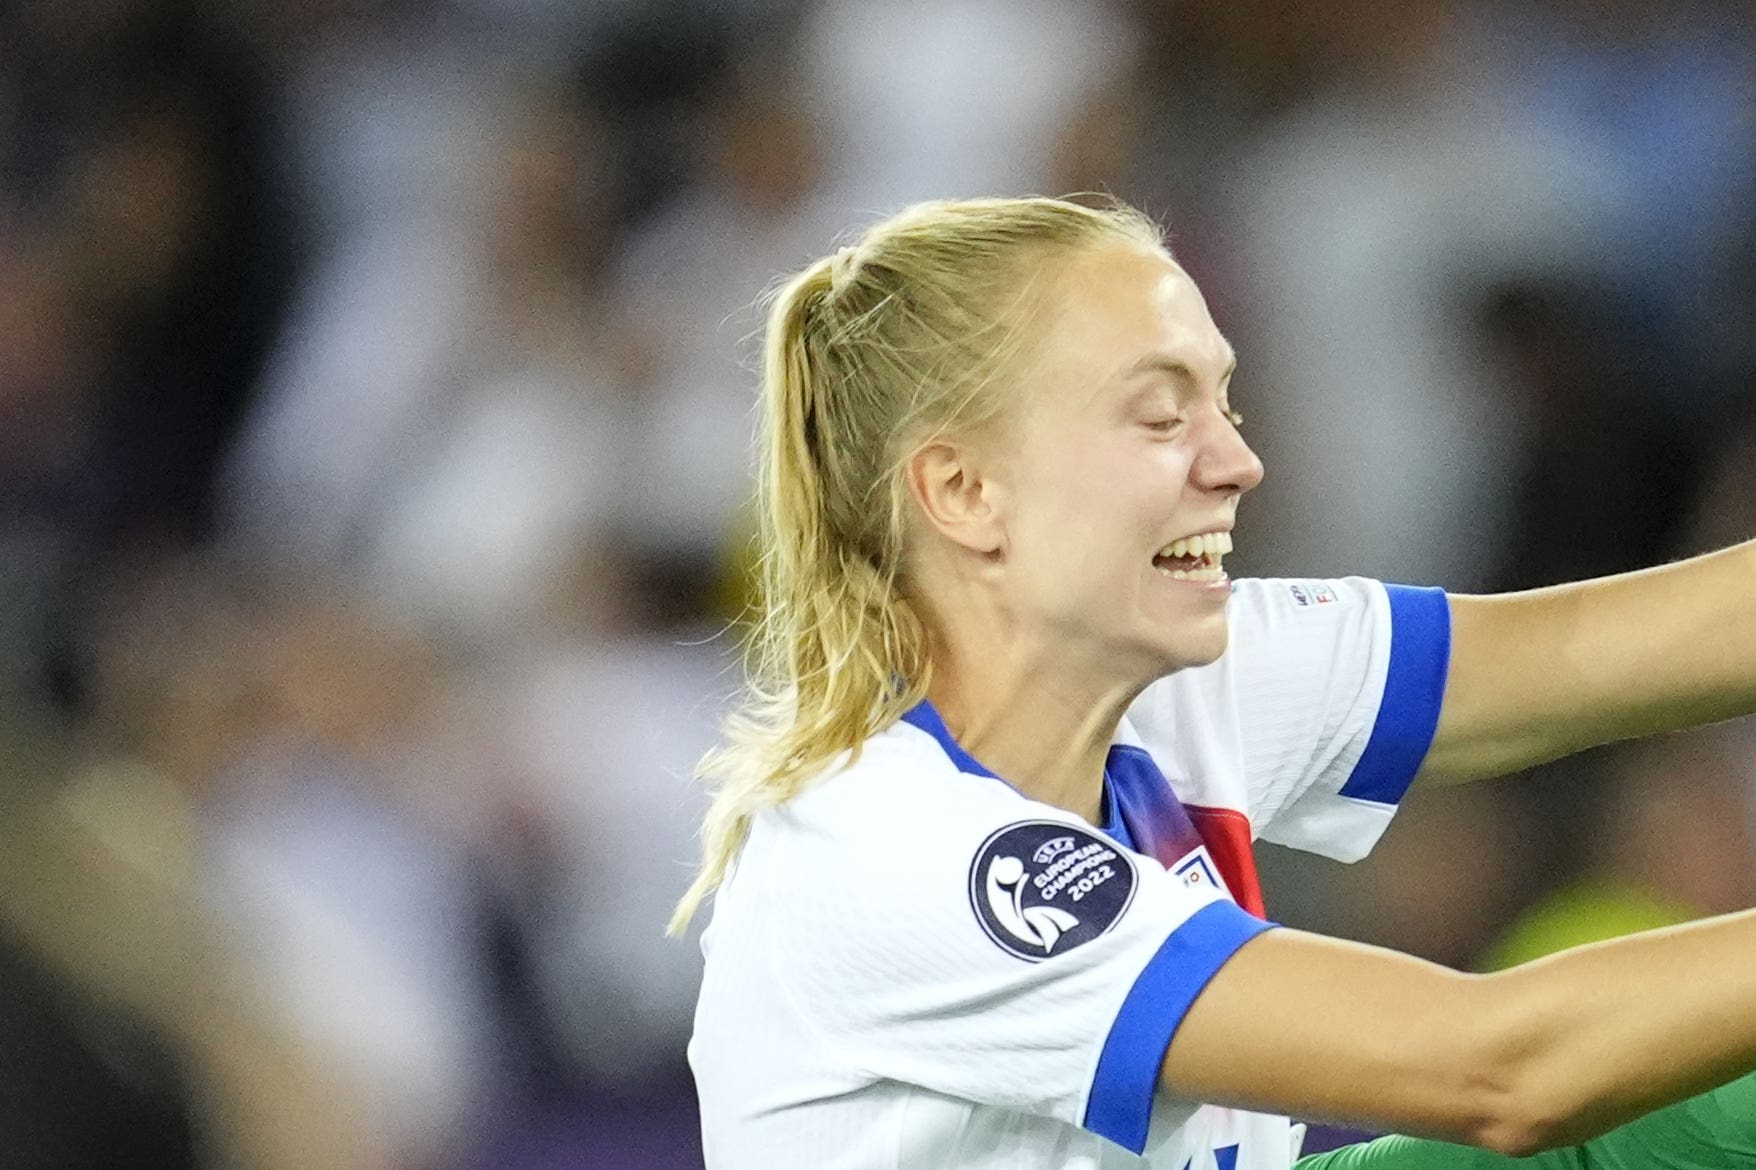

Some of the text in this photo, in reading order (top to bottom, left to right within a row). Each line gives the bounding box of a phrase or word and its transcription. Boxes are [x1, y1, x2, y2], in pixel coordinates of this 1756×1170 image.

[1033, 843, 1104, 889] EUROPEAN
[1036, 839, 1075, 864] UEFA
[1041, 849, 1117, 901] CHAMPIONS
[1067, 865, 1117, 902] 2022
